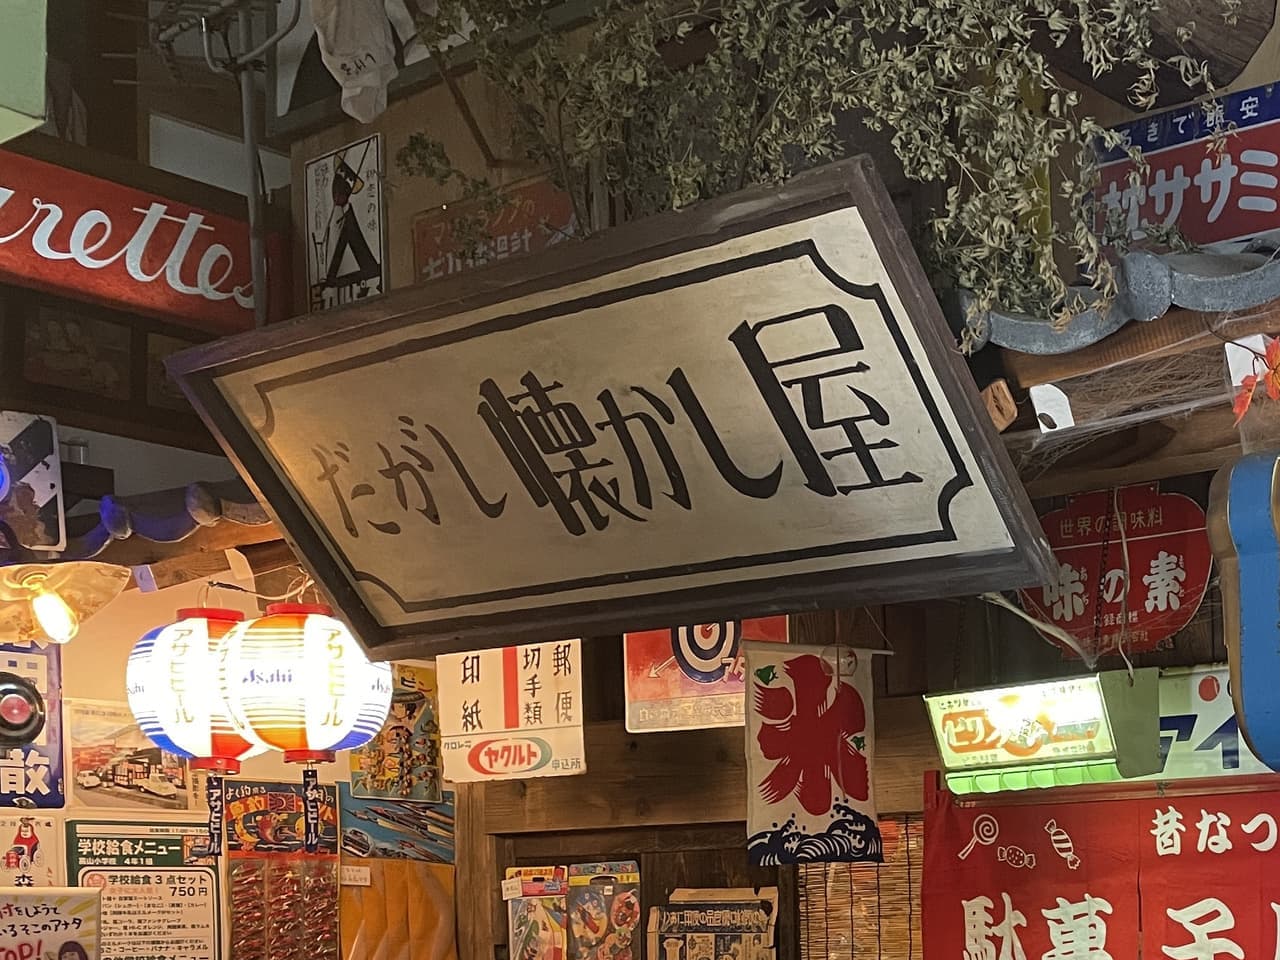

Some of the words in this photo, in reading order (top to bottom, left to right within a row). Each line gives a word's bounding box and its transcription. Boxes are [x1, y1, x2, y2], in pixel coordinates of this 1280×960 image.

[0, 188, 257, 307] rettes
[314, 303, 923, 538] だがし懐かし屋
[1043, 550, 1187, 622] 味の素
[460, 655, 483, 733] 印紙
[522, 647, 544, 726] 切手類
[552, 642, 573, 725] 郵便
[484, 742, 540, 770] ヤクルト
[551, 757, 582, 770] 申込所
[754, 654, 869, 816] 氷
[78, 838, 181, 856] 学校給食メニュー
[169, 886, 208, 897] 750円
